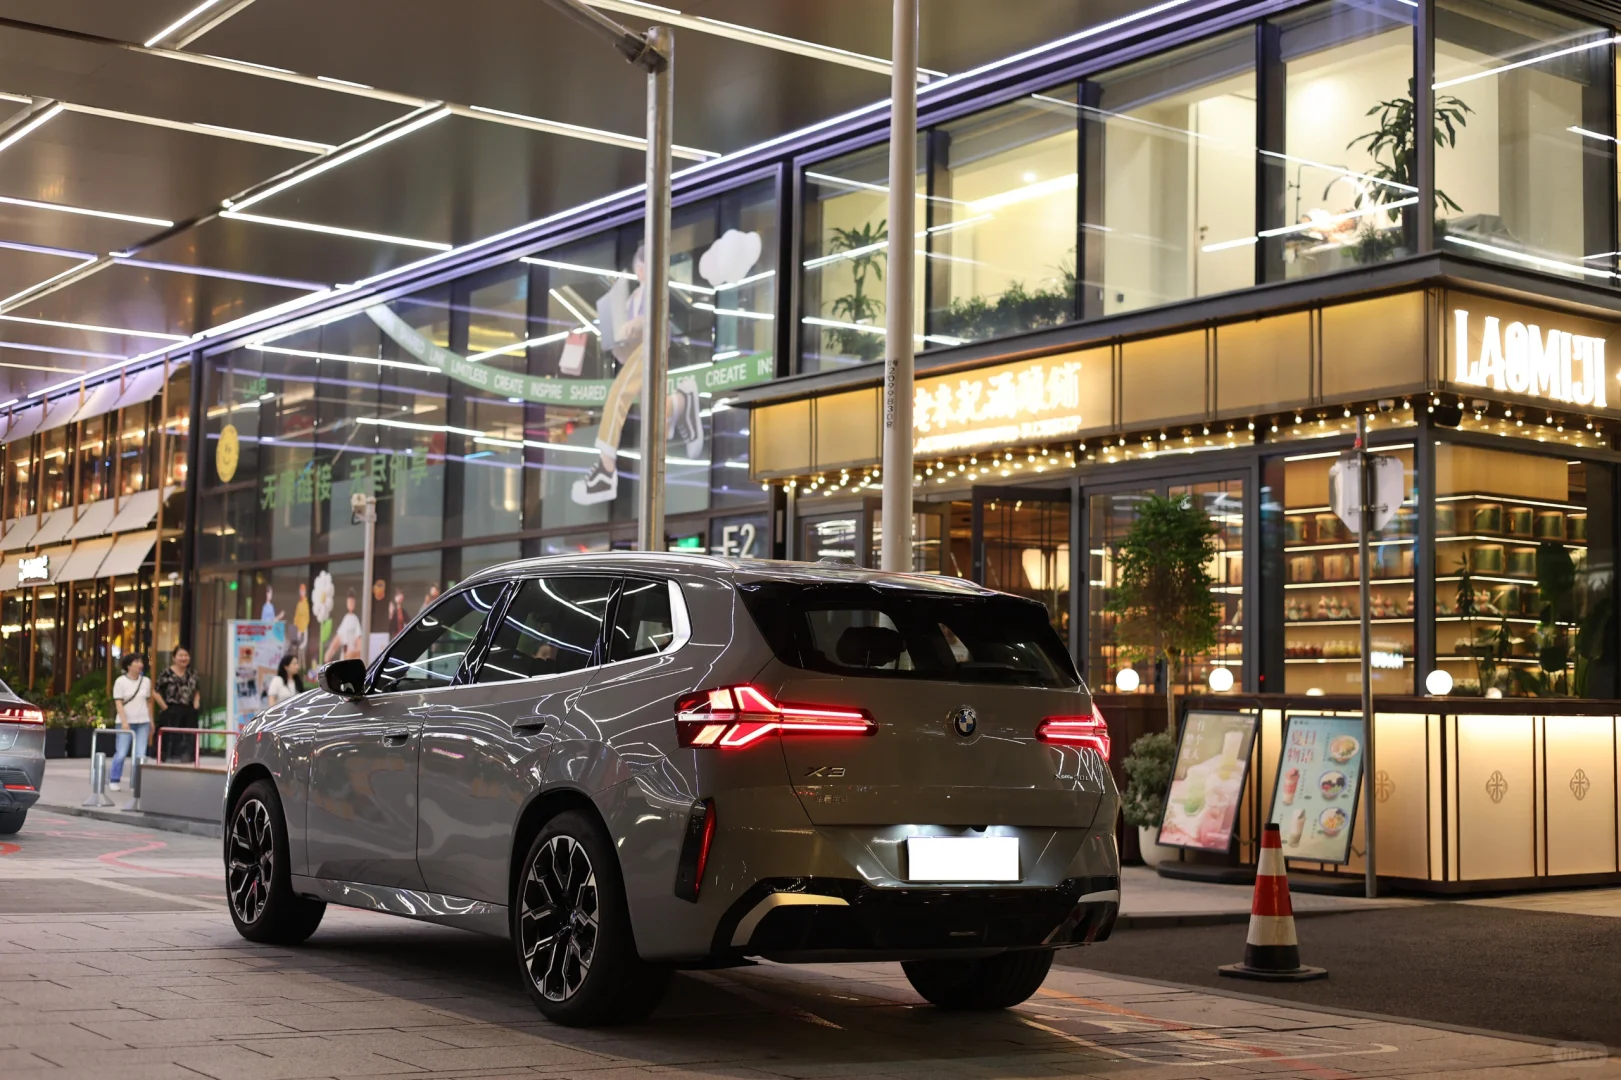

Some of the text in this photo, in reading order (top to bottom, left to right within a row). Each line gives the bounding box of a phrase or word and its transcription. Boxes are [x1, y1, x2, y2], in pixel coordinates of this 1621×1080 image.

[1454, 308, 1607, 408] LAOMIJI
[451, 360, 488, 385] LIMITLESS
[494, 374, 524, 394] CREATE
[530, 381, 562, 400] INSPIRE
[569, 384, 606, 401] SHARED
[706, 363, 747, 387] CREATE
[805, 766, 846, 778] X3
